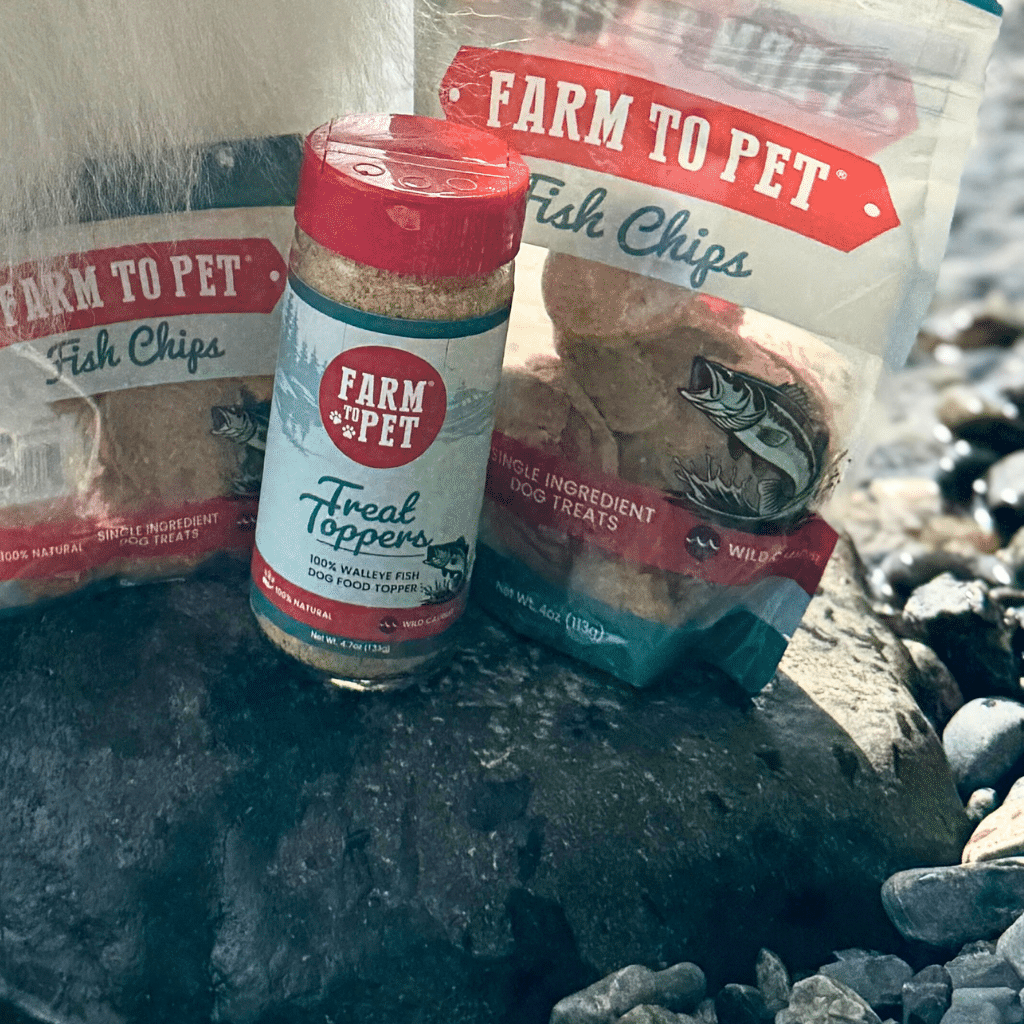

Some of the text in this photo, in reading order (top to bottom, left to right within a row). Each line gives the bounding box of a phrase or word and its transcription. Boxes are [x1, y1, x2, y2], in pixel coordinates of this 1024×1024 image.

[486, 70, 634, 152] FARM
[648, 102, 711, 172] TO
[527, 172, 753, 289] Fish Chips
[110, 257, 162, 303] TO
[170, 254, 241, 297] PET
[46, 321, 225, 385] Fish Chips
[337, 365, 427, 413] FARM
[343, 404, 360, 422] TO
[357, 409, 420, 449] PET
[317, 475, 420, 524] Treat
[491, 446, 657, 524] SINGLE INGREDIENT
[510, 477, 619, 532] DOG TREATS
[97, 511, 219, 543] SINGLE INGREDIENT
[119, 528, 199, 547] DOG TREATS
[299, 492, 434, 556] Toppers
[0, 550, 29, 563] 100%
[310, 553, 420, 581] 100% WALLEYE FISH
[729, 543, 769, 563] WILD
[308, 567, 418, 594] DOG FOOD TOPPER
[275, 585, 333, 621] 100% NATURAL
[310, 629, 325, 644] Net
[565, 612, 605, 643] (113g)
